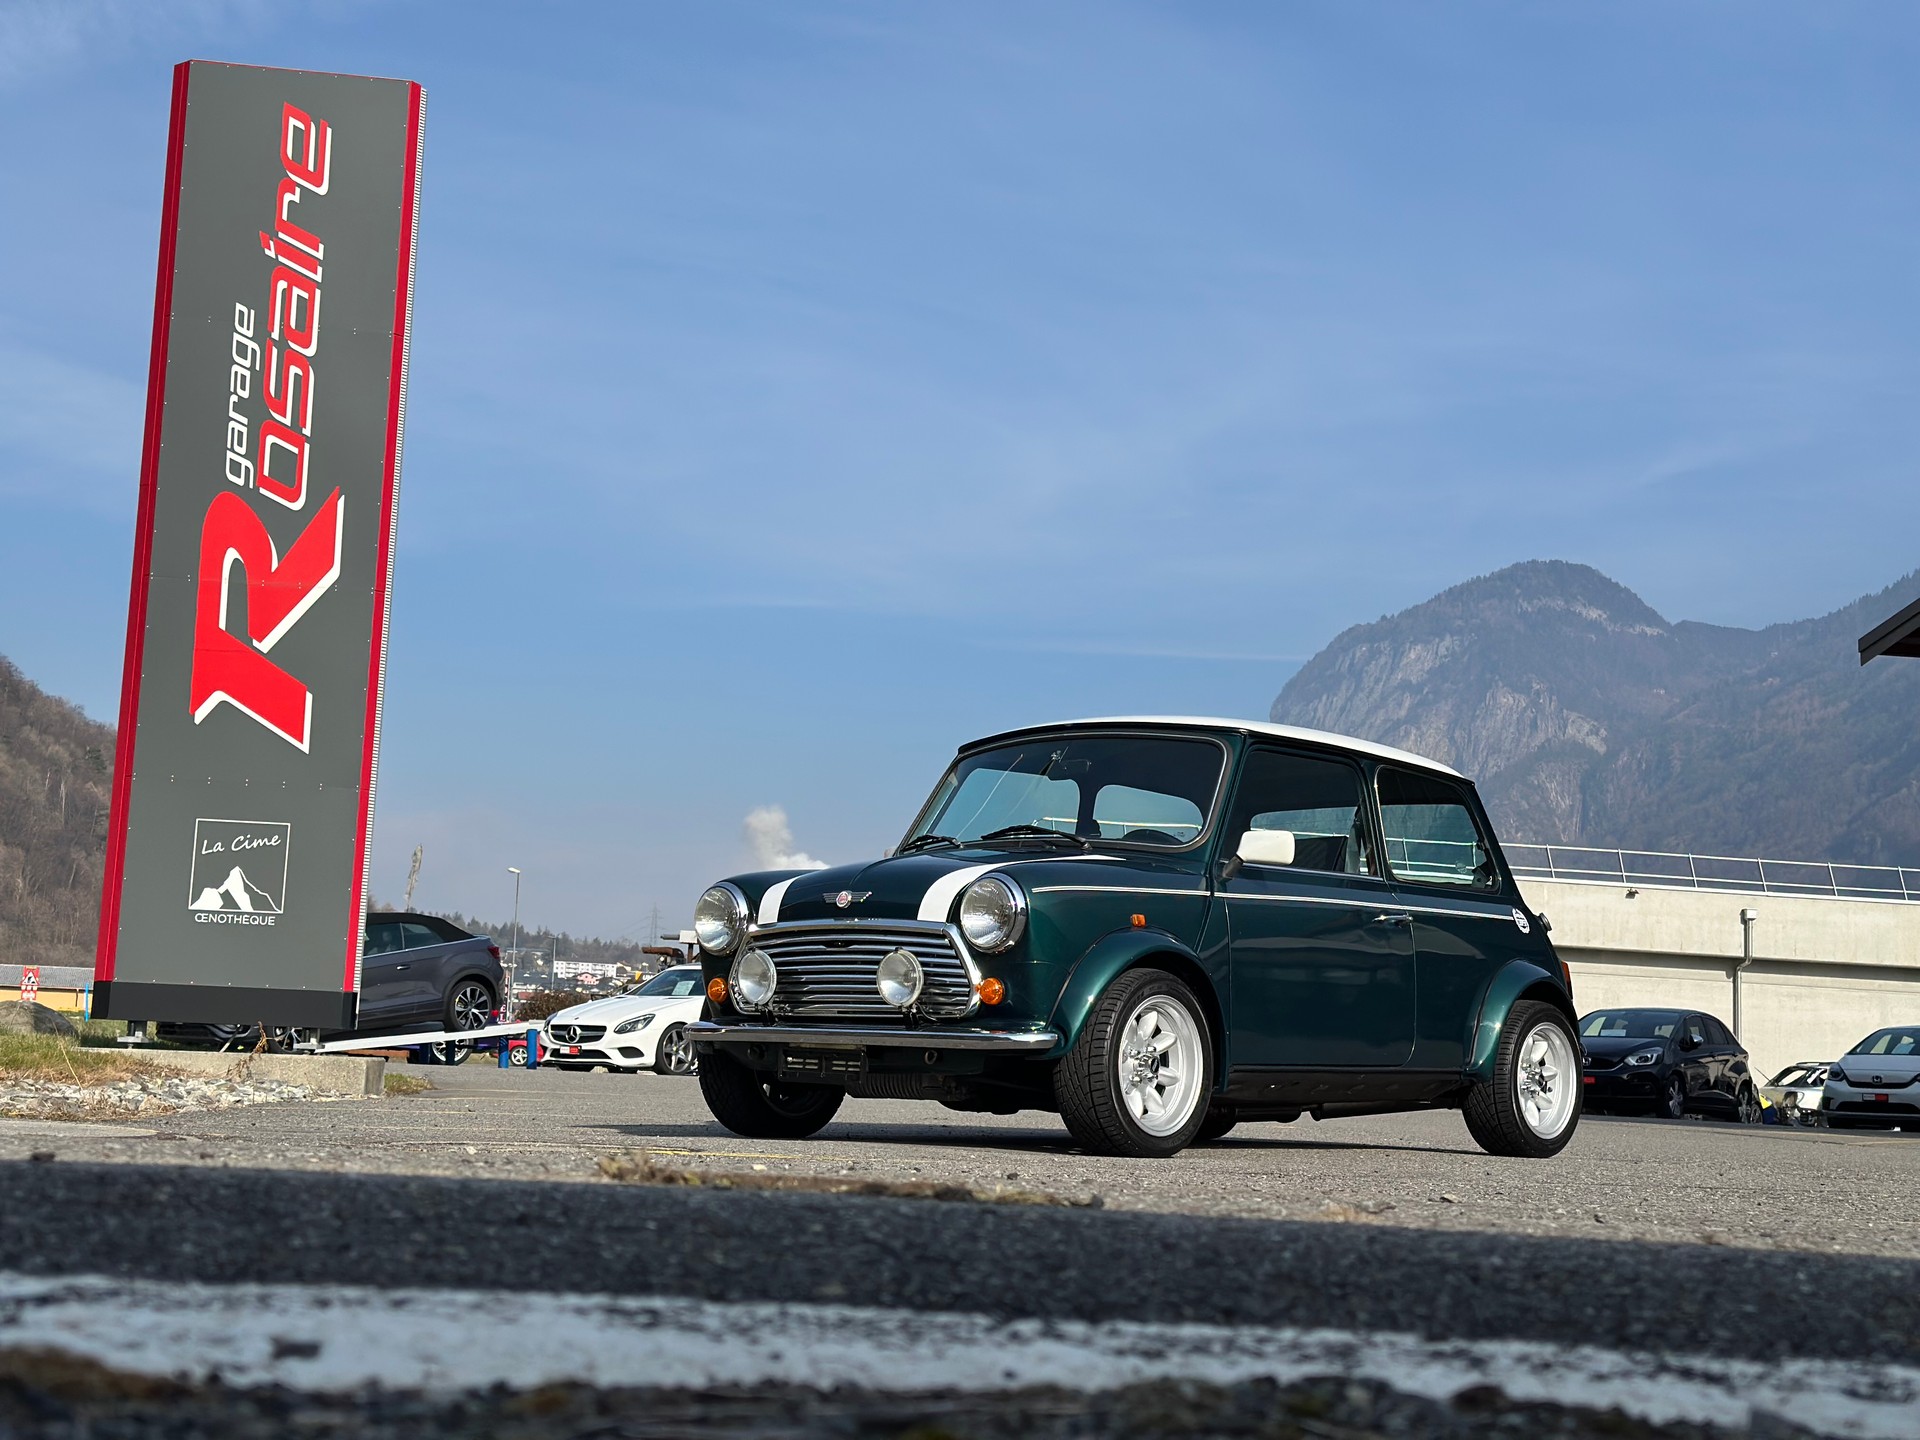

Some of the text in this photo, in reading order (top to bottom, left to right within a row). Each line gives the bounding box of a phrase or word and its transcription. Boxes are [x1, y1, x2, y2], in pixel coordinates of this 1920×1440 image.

[189, 101, 345, 755] Rosaire
[225, 302, 261, 489] garage
[201, 834, 281, 855] La Cime
